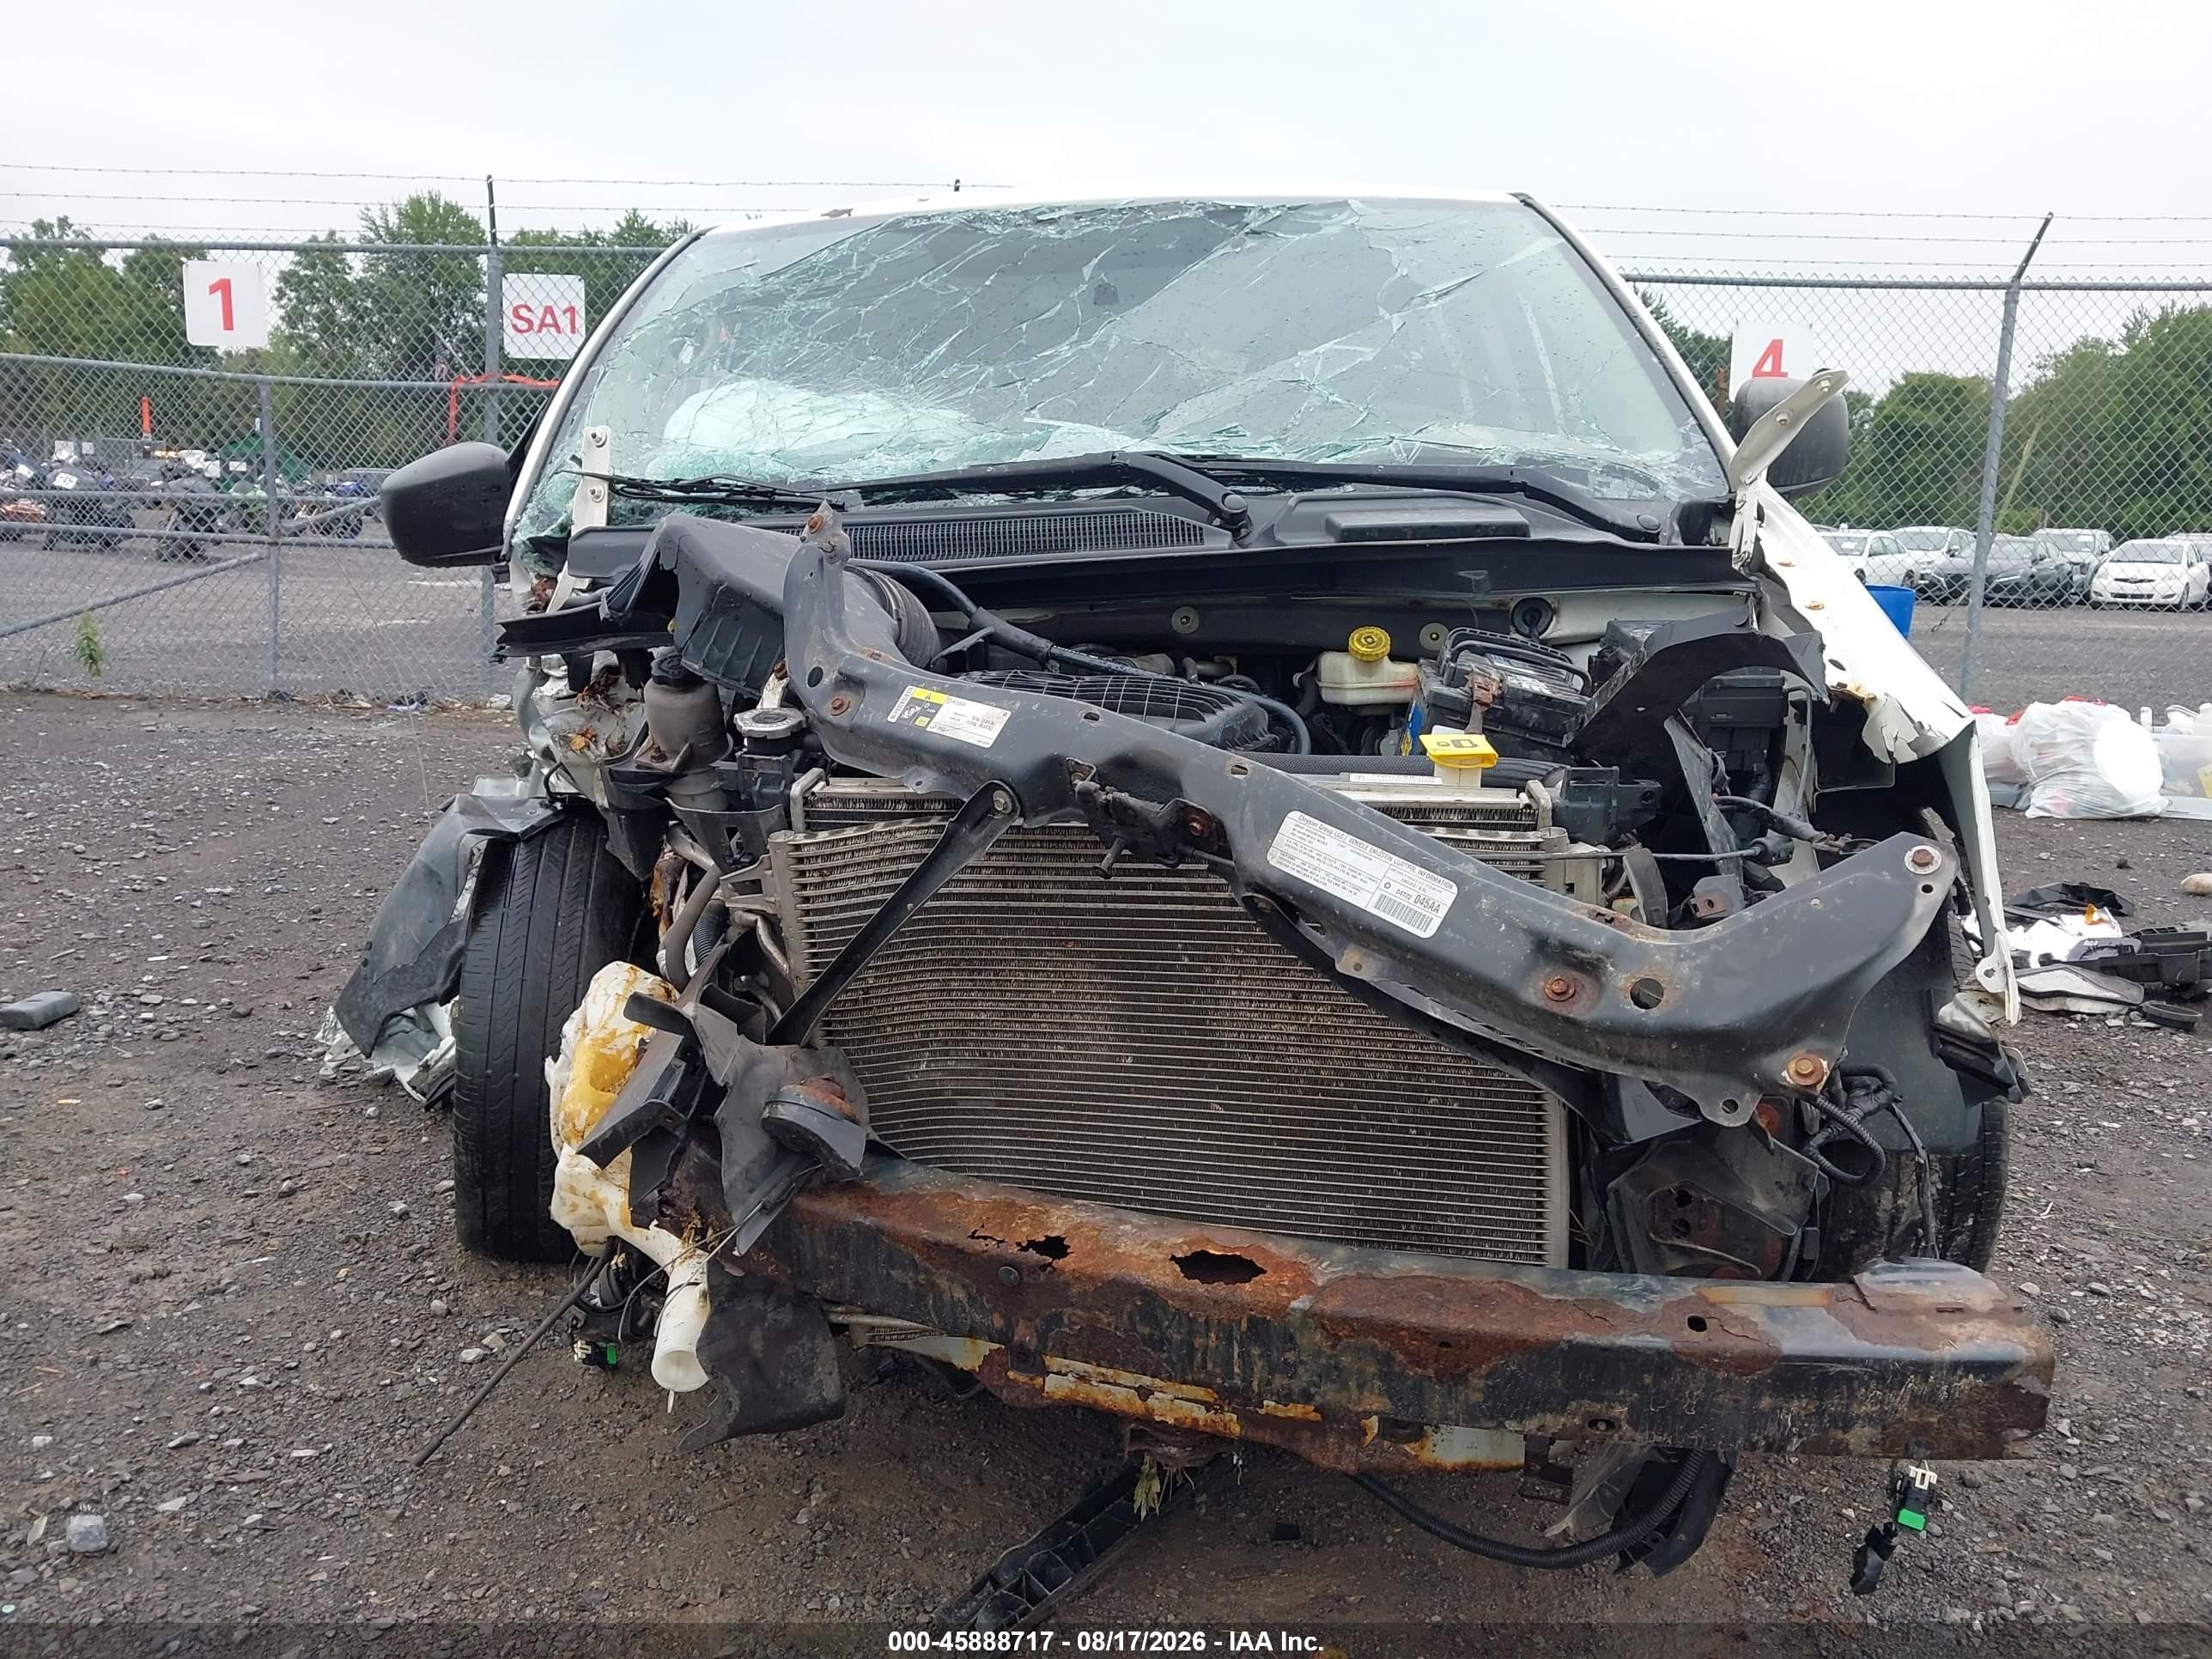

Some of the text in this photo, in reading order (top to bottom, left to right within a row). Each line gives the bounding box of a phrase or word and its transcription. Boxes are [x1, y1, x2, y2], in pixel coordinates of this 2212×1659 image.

[209, 278, 234, 331] 1
[511, 305, 579, 335] SA1
[1752, 339, 1789, 378] 4
[1297, 814, 1319, 829] Chrysler
[1317, 823, 1334, 835] Group
[1333, 830, 1344, 839] LLC
[1347, 837, 1369, 851] VEHICLE
[1369, 847, 1393, 861] EMISSION
[1393, 858, 1417, 872] CONTROL
[1417, 868, 1454, 890] INFORMATION
[1413, 893, 1441, 913] 045AA
